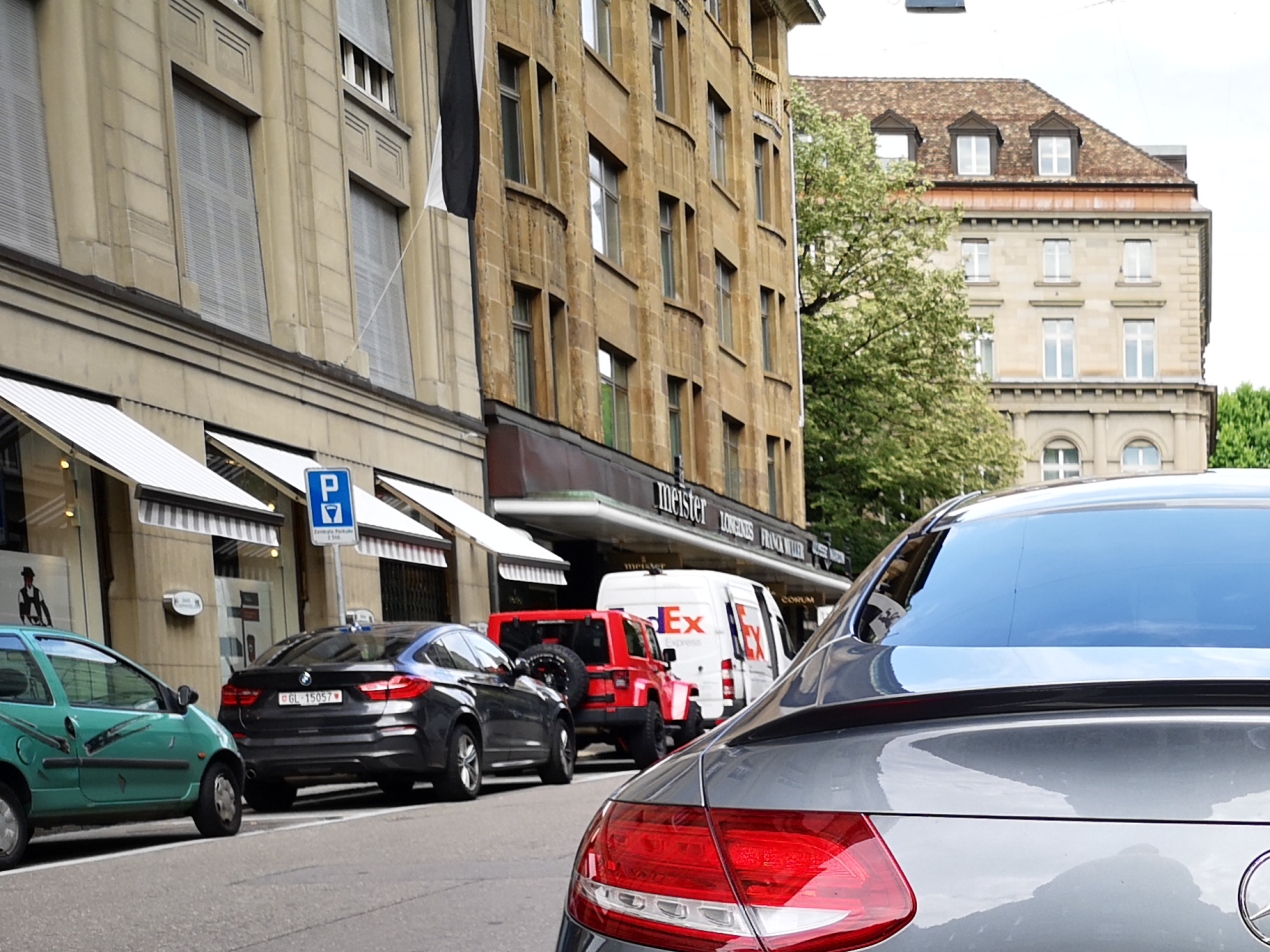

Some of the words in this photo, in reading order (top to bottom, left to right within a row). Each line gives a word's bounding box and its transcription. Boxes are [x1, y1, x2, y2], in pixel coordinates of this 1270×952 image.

[320, 474, 339, 502] P
[657, 481, 707, 525] meister
[719, 510, 754, 541] LONGINES
[665, 638, 702, 648] Express
